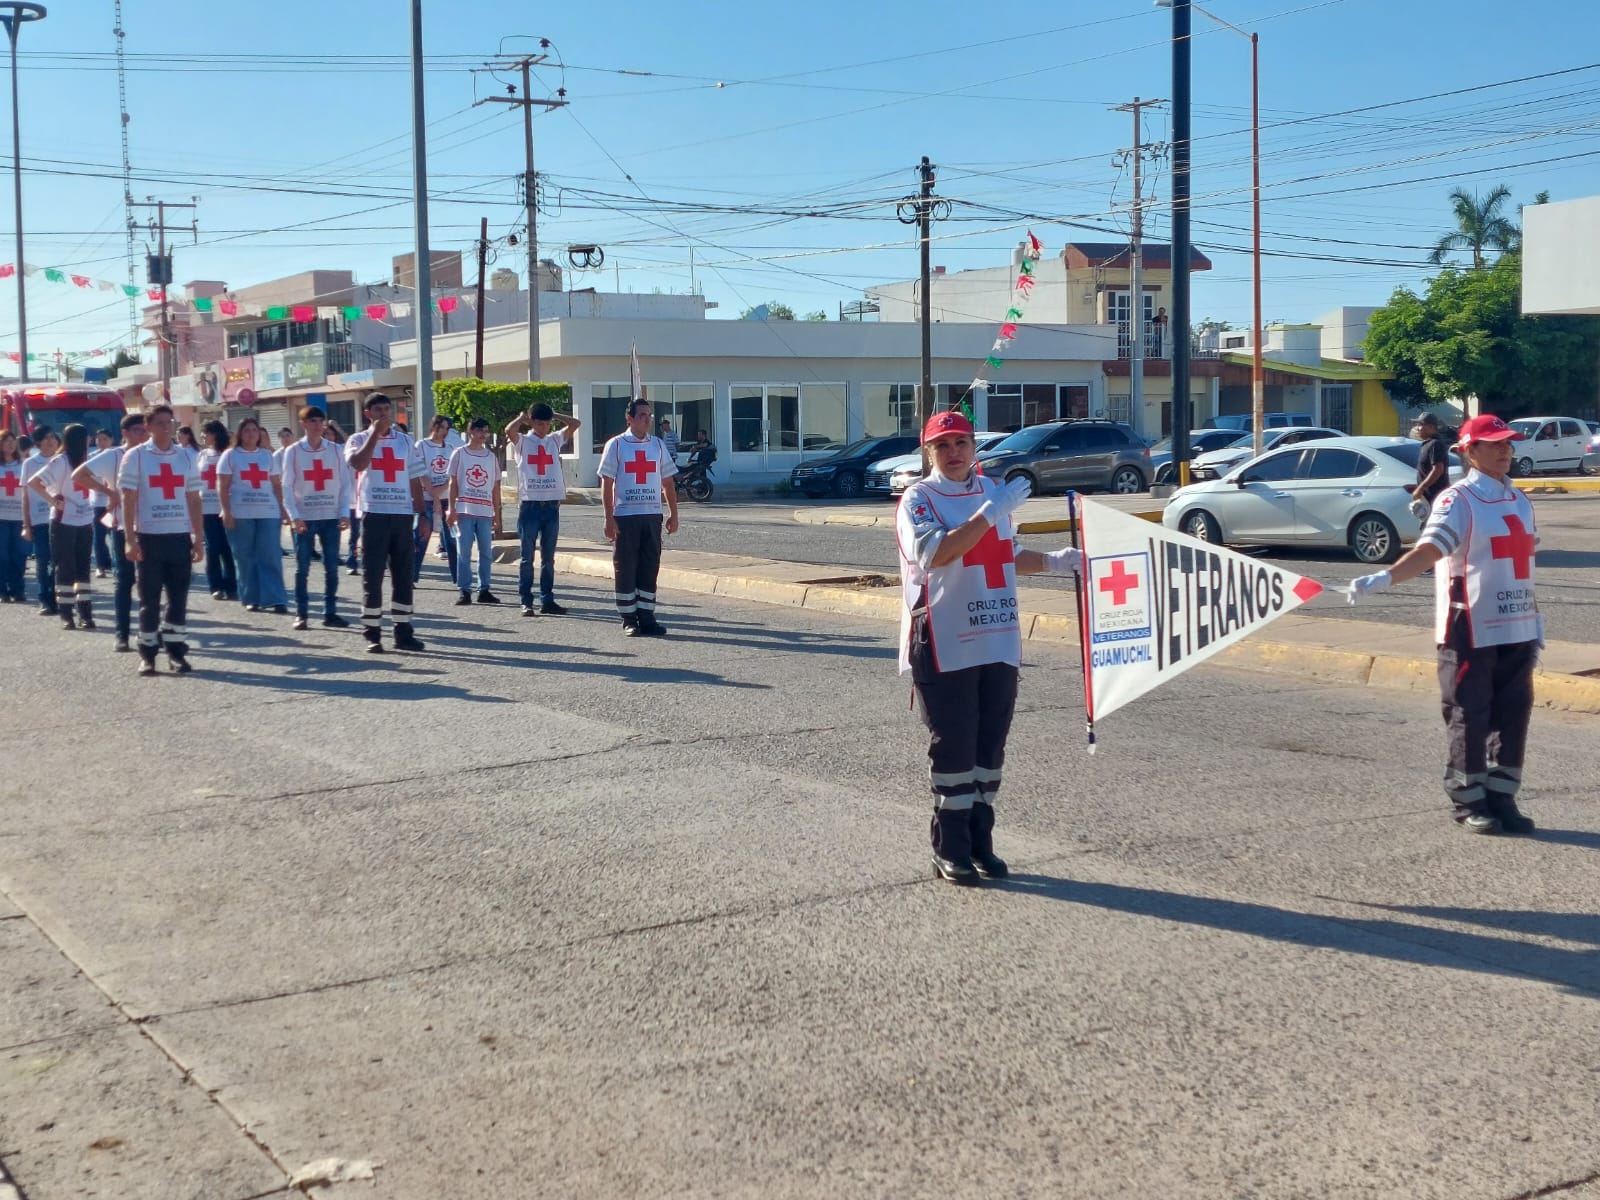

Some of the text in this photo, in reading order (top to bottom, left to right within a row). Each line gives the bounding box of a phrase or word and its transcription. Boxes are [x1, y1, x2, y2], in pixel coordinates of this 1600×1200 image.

[1496, 589, 1523, 601] CRUZ
[967, 597, 1017, 612] CRUZ RO
[1149, 537, 1284, 672] VETERANOS
[969, 612, 1017, 626] MEXICA
[1099, 608, 1144, 620] CRUZ ROJA
[1099, 617, 1144, 629] MEXICANA
[1094, 628, 1151, 642] VETERANOS
[1092, 643, 1152, 668] GUAMUCHIL
